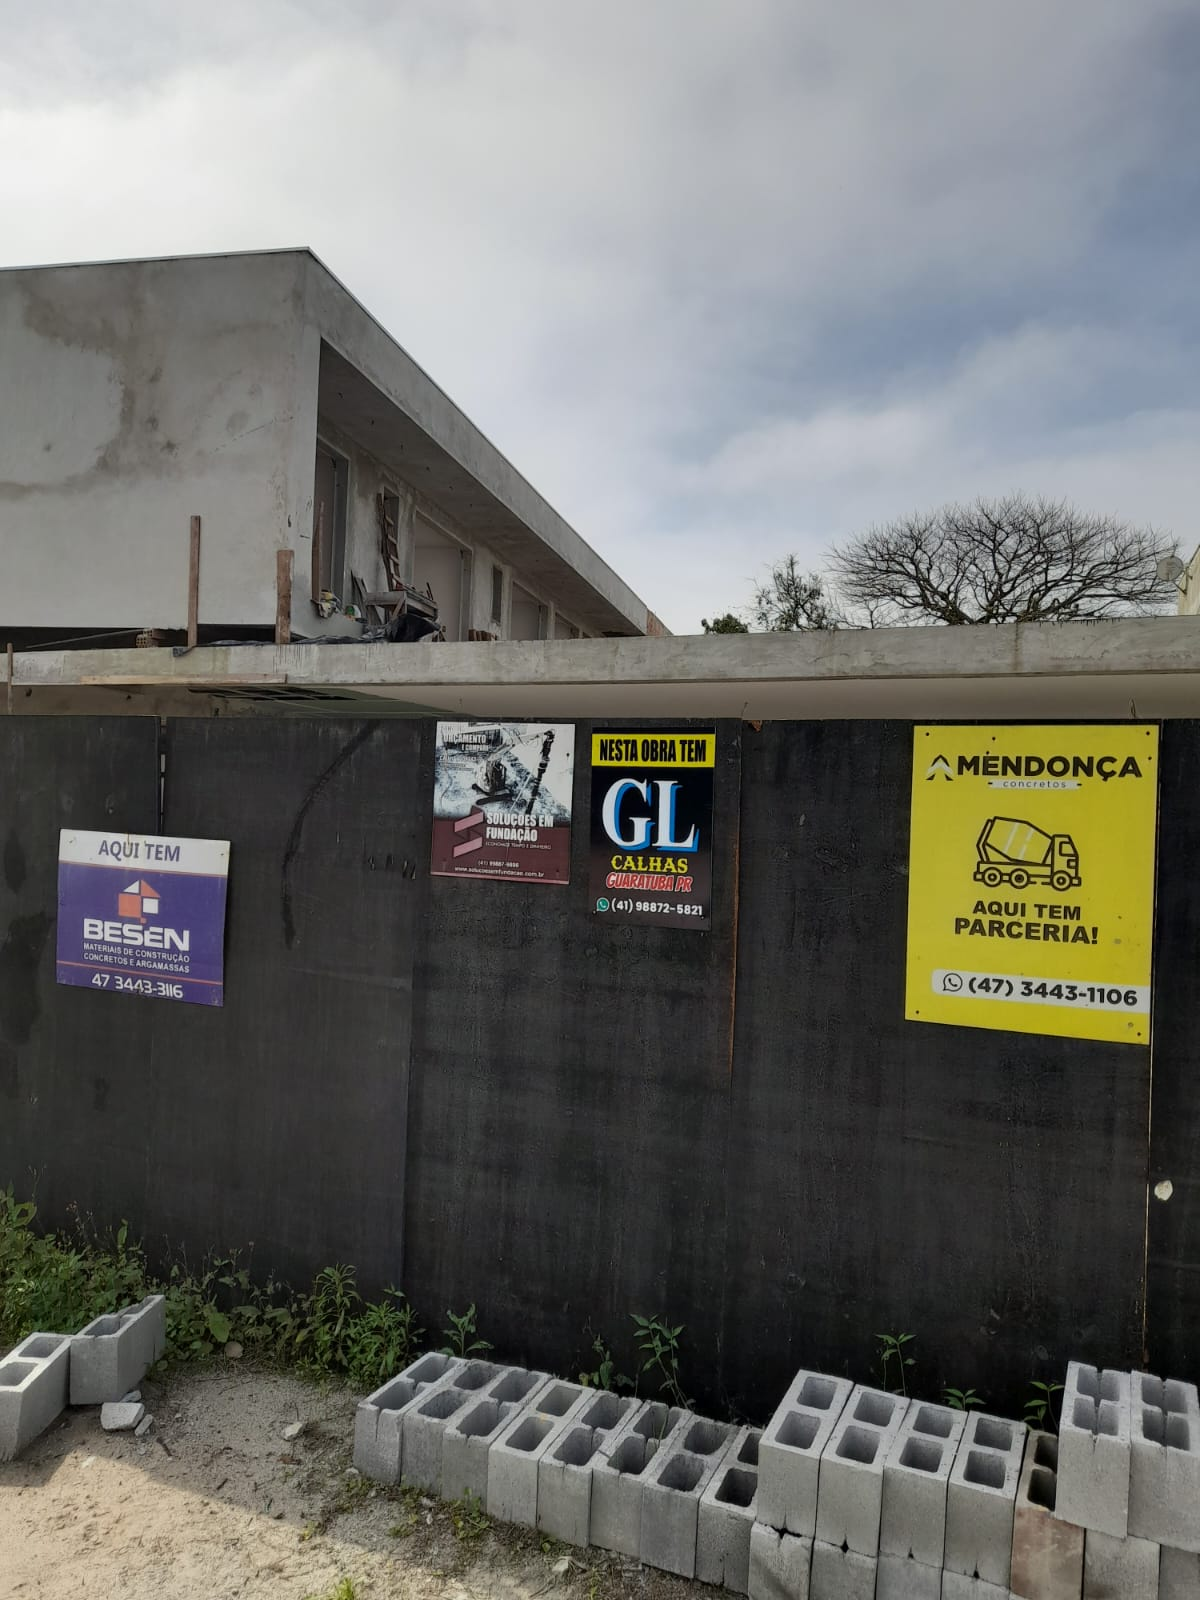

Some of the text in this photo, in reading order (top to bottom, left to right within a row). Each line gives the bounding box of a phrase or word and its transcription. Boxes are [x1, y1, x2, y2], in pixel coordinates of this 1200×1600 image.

[600, 738, 707, 762] NESTA OBRA TEM
[957, 754, 1143, 781] MENDONÇA
[1002, 779, 1067, 788] concretos
[538, 814, 554, 828] EM
[601, 777, 700, 852] GL
[486, 826, 538, 843] FUNDAÇÃO
[98, 840, 181, 862] AQUI TEM
[610, 855, 688, 874] CALHAS
[605, 871, 693, 893] GUARATUBA PR
[611, 898, 703, 916] (41) 98872-5821
[972, 899, 1081, 921] AQUI TEM
[83, 918, 190, 951] BESEN
[954, 917, 1099, 945] PARCERIA!
[83, 942, 190, 964] MATERIAIS DE CONSTRUÇÃO
[83, 952, 190, 974] CONCRETOS E ARGAMASSAS
[91, 973, 184, 998] 47 3443-3116
[968, 975, 1138, 1007] (47) 3443-1106
